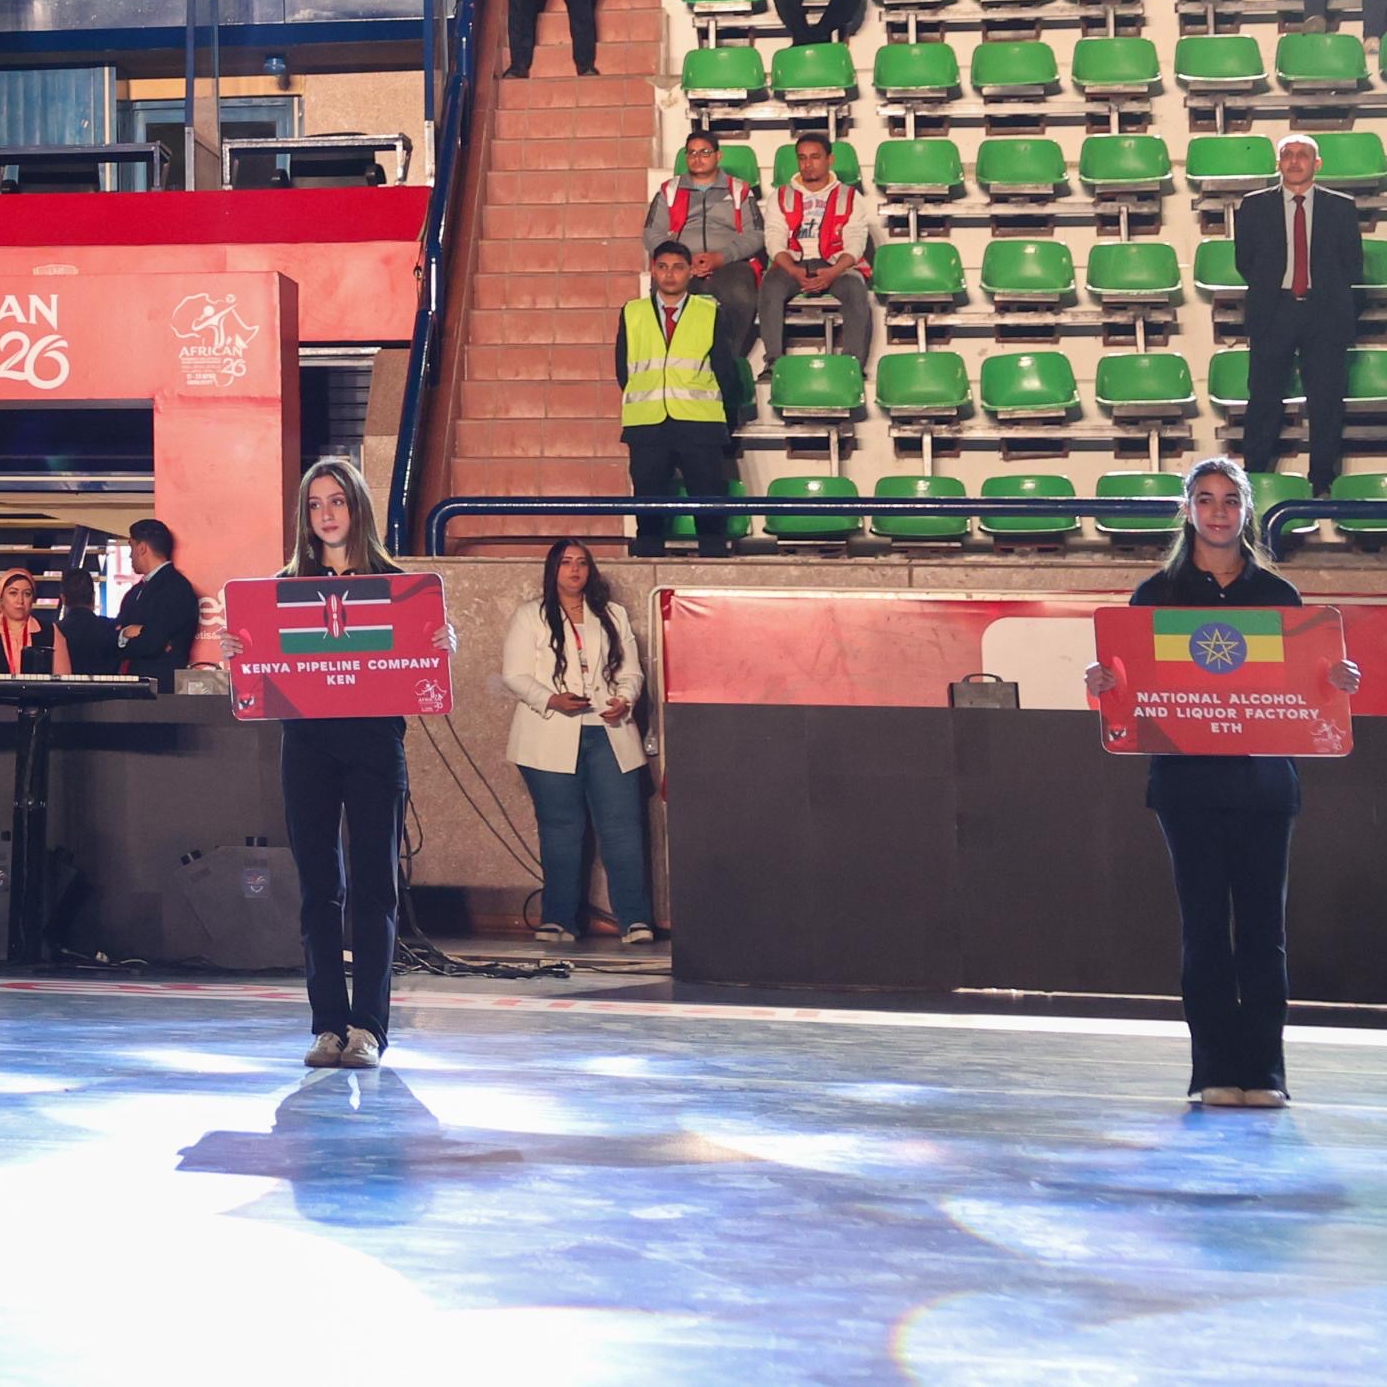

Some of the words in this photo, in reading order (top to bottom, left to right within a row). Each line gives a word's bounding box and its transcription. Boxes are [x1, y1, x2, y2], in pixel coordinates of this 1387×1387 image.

[179, 346, 243, 358] AFRICAN
[221, 358, 246, 377] 26
[241, 663, 290, 675] KENYA
[297, 660, 361, 673] PIPELINE
[368, 657, 440, 670] COMPANY
[327, 674, 356, 685] KEN
[1136, 692, 1221, 704] NATIONAL
[1229, 693, 1307, 705] ALCOHOL
[1133, 706, 1168, 718] AND
[1176, 707, 1237, 719] LIQUOR
[1245, 707, 1319, 720] FACTORY
[1210, 722, 1243, 734] ETH
